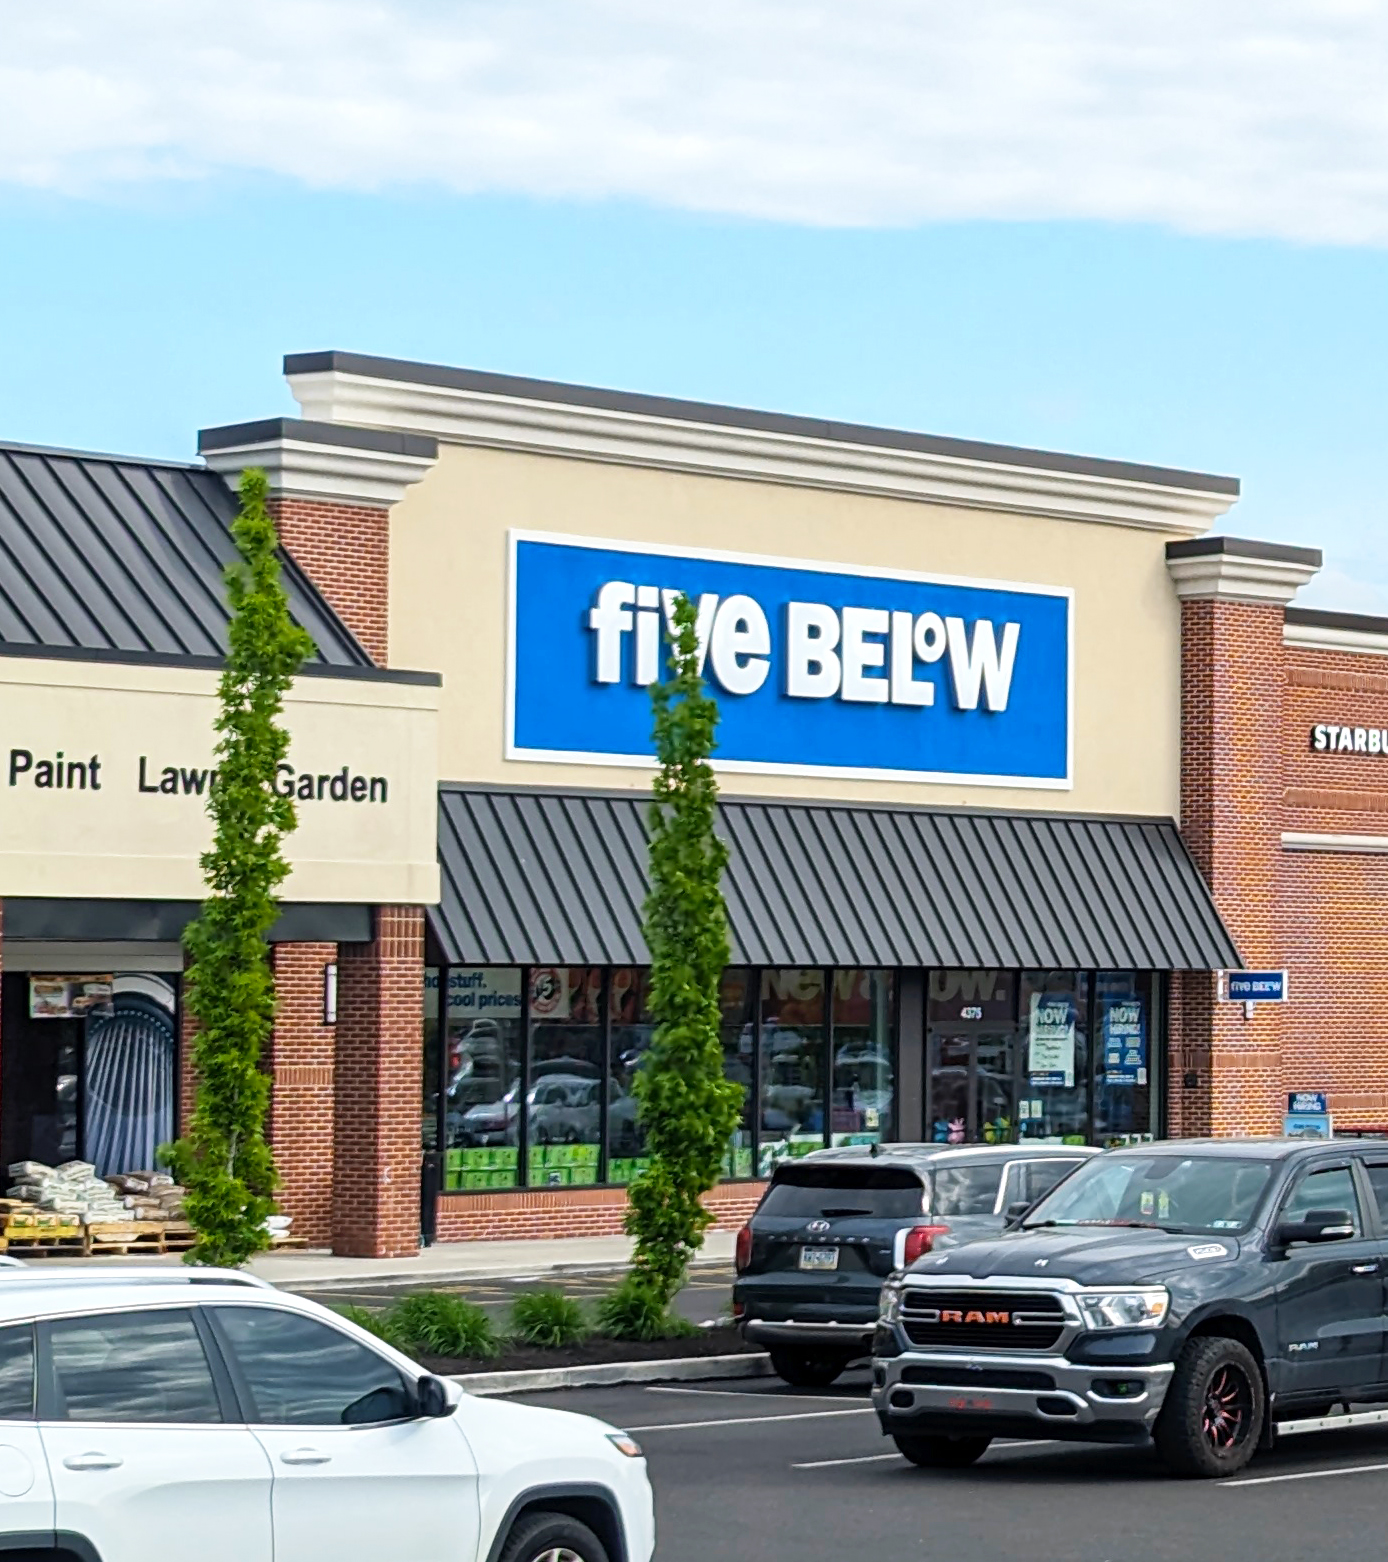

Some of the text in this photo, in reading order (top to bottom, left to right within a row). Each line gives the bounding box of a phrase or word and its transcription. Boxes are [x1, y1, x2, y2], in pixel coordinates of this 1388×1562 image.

[589, 580, 771, 695] five
[9, 748, 102, 791] Paint
[272, 763, 389, 803] Garden
[447, 992, 476, 1007] cool
[941, 1309, 1010, 1324] RAM
[1288, 1341, 1319, 1352] RAM
